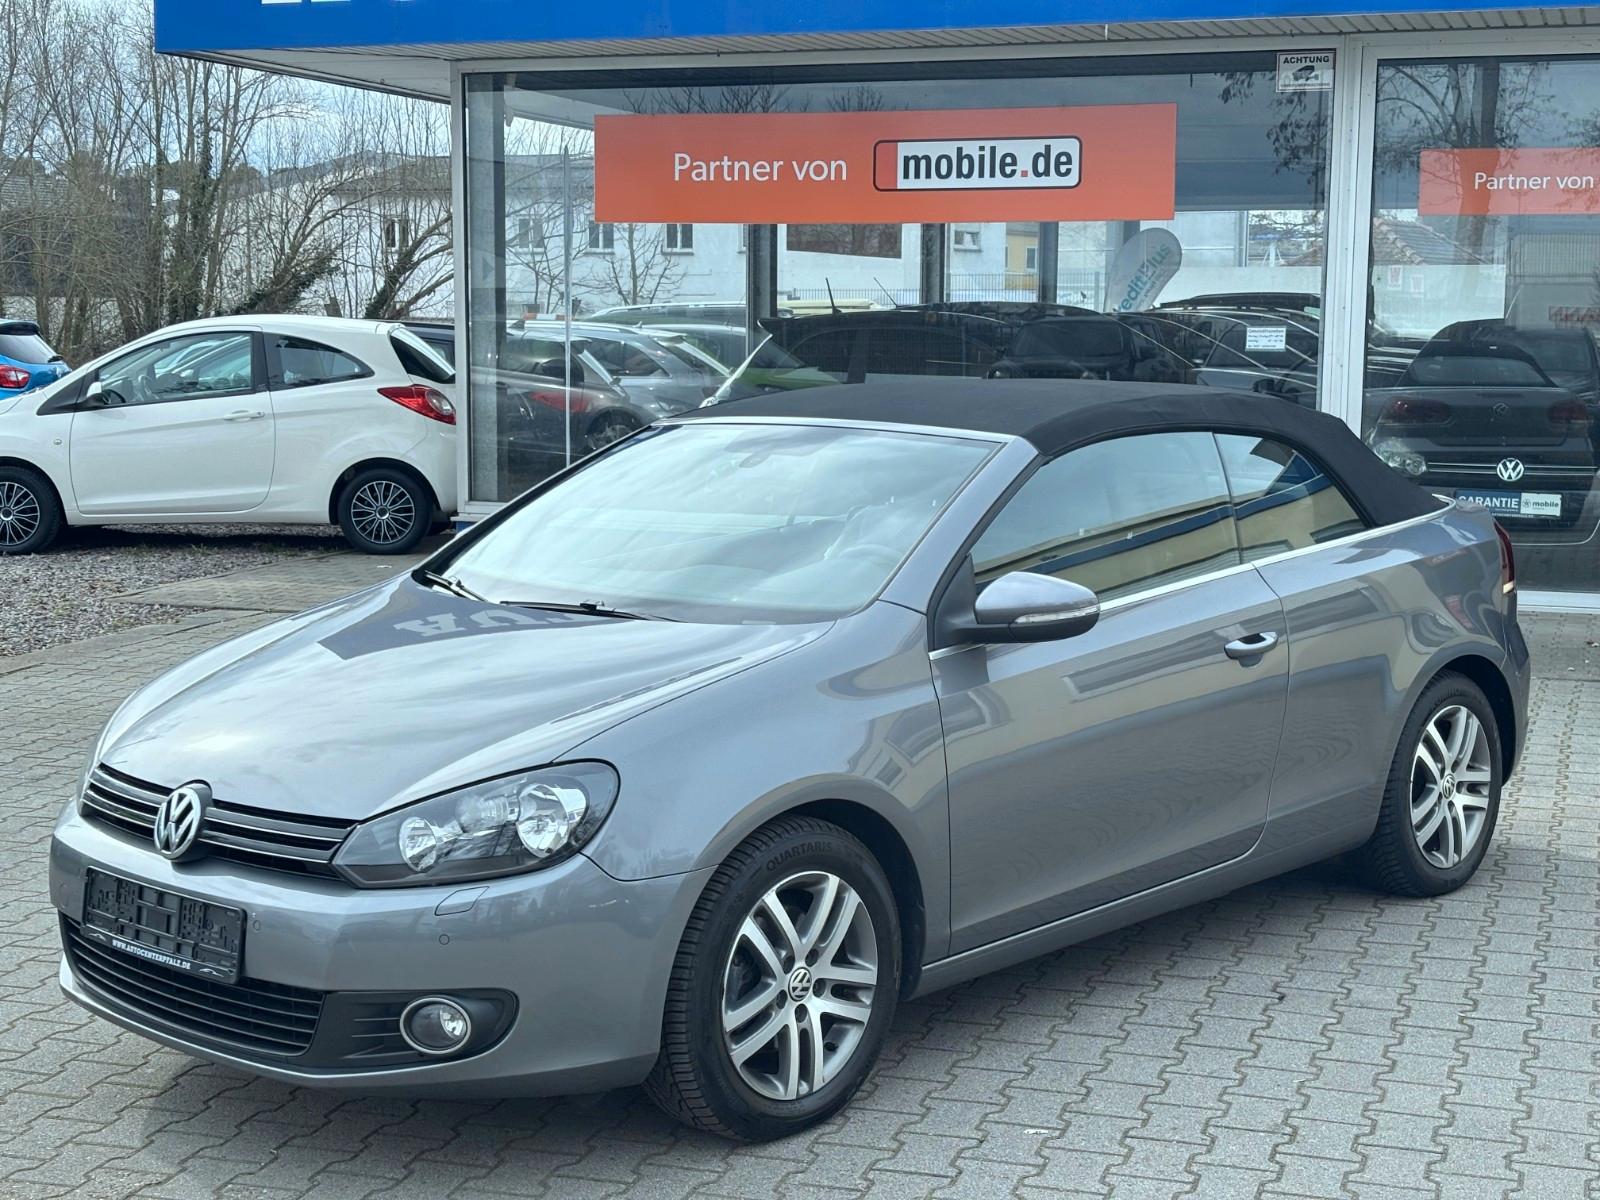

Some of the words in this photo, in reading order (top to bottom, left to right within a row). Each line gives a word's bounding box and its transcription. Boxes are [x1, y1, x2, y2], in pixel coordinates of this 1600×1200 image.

[1283, 55, 1330, 64] ACHTUNG
[673, 153, 784, 183] Partner
[792, 159, 848, 182] von
[902, 144, 1074, 180] mobile.de
[1474, 172, 1551, 190] Partner
[1556, 175, 1594, 189] von
[766, 841, 833, 872] QUARTARIS
